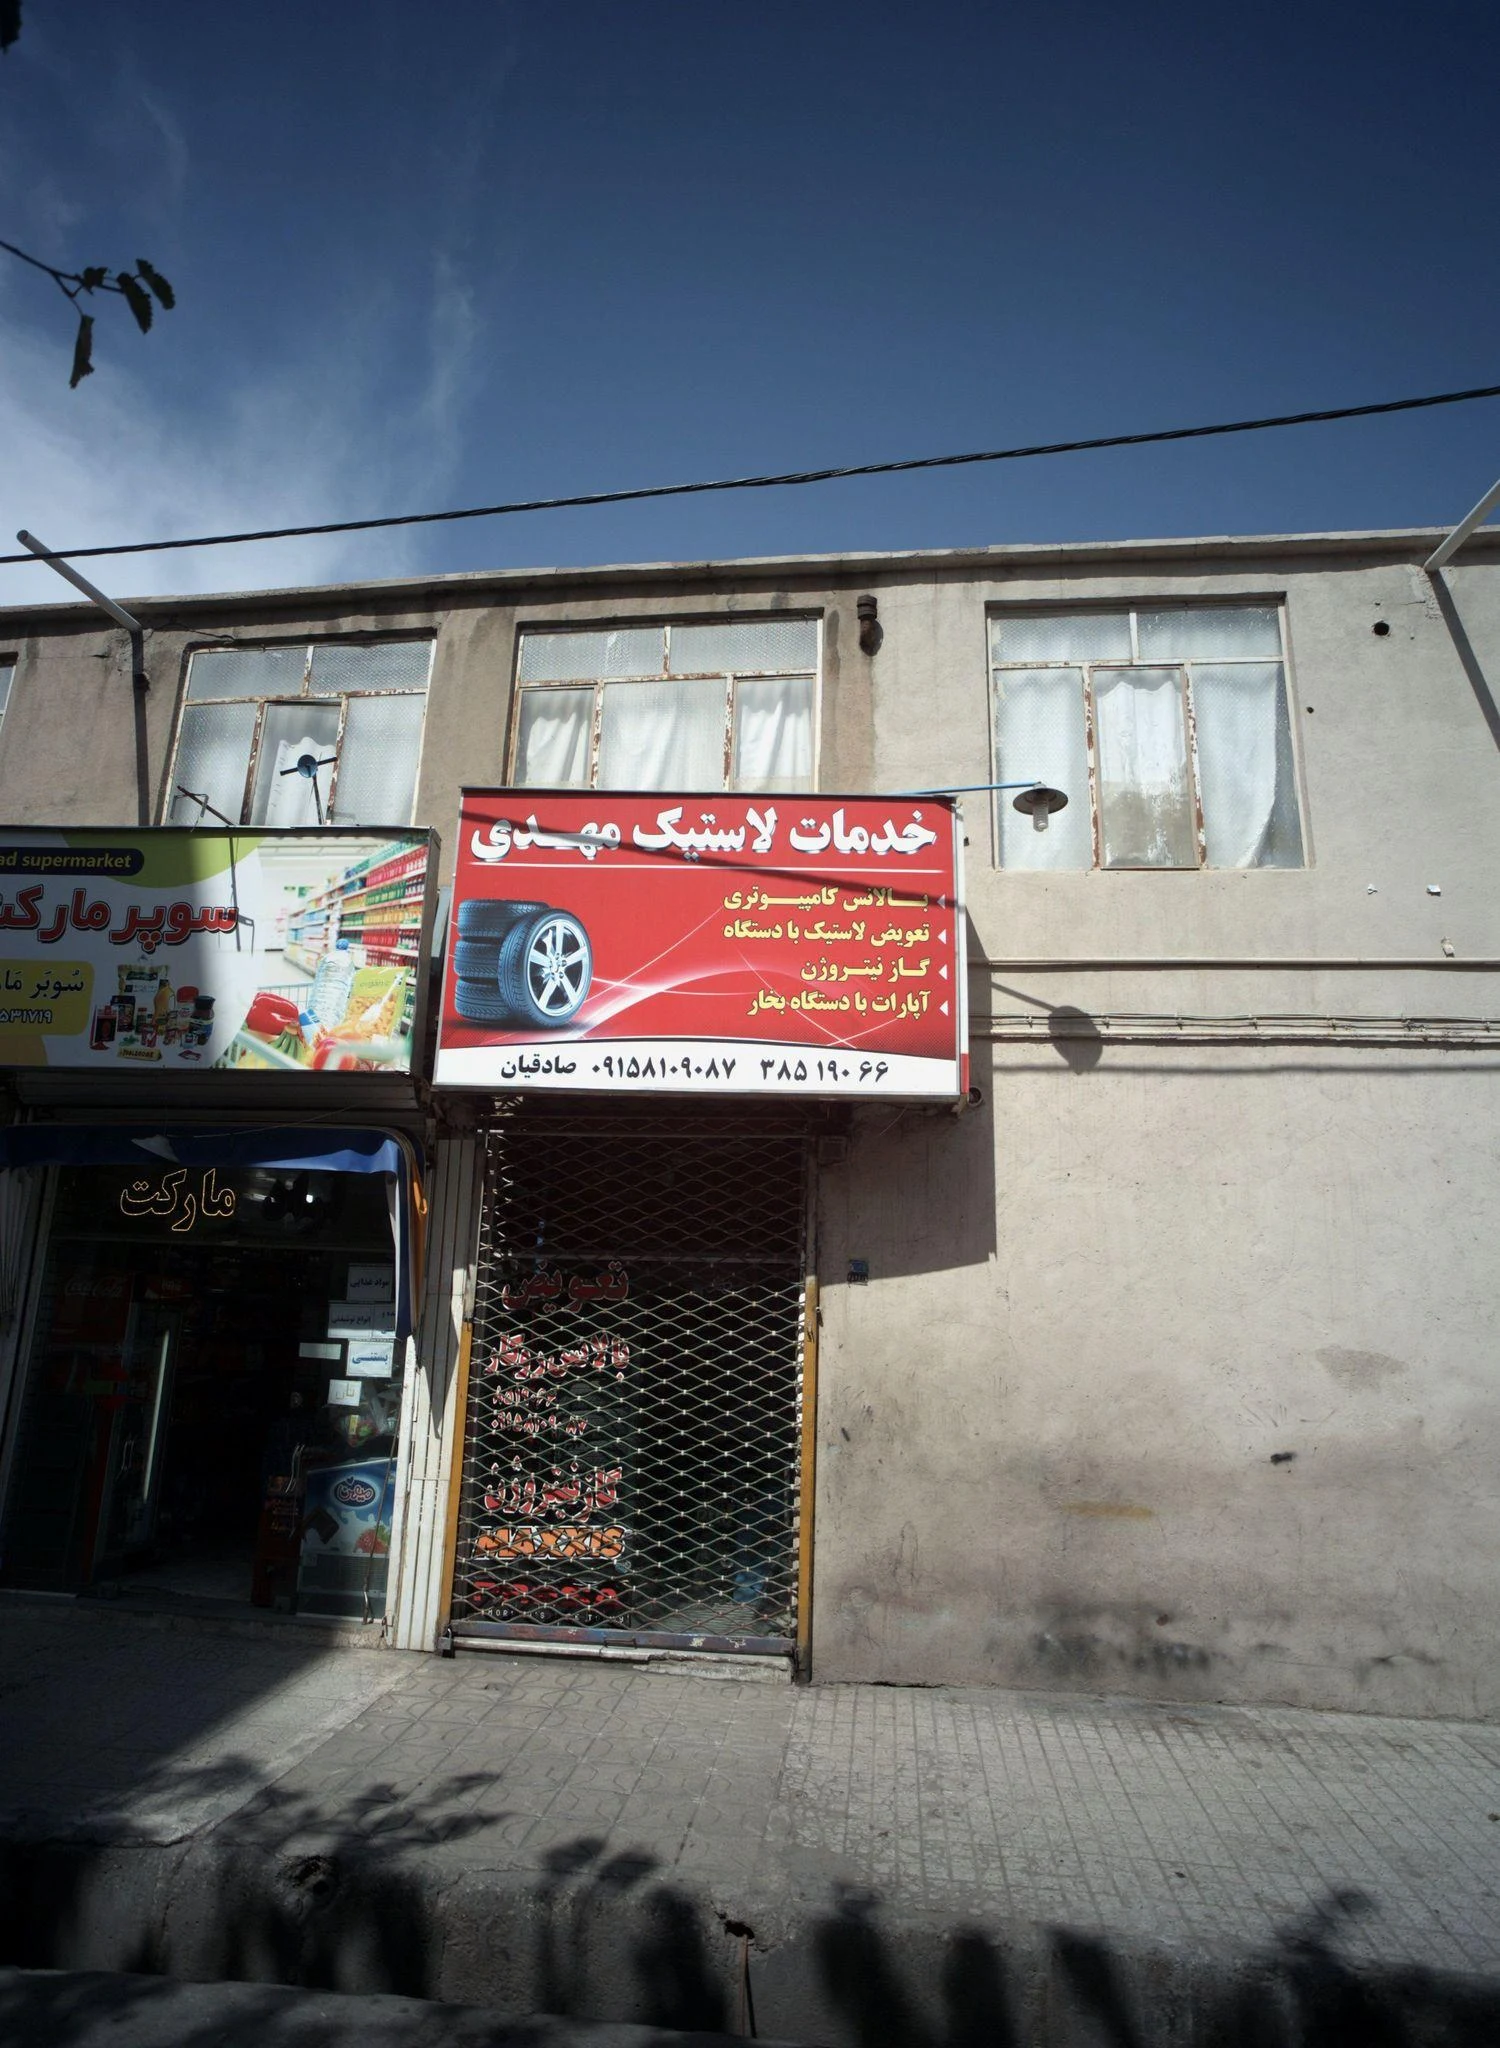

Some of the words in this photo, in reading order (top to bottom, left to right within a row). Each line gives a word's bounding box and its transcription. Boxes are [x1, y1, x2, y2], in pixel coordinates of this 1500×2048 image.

[471, 814, 622, 862] مهدی
[633, 806, 778, 863] لاستیک
[788, 807, 938, 856] خدمات
[21, 852, 133, 871] supermarket
[723, 885, 838, 911] کامپیوتری
[843, 886, 929, 912] بالانس
[109, 902, 239, 954] سوپر
[723, 919, 783, 940] دستگاه
[787, 920, 800, 944] با
[803, 920, 867, 945] لاستیک
[870, 922, 930, 948] تعویض
[800, 956, 883, 982] نیتروژن
[888, 957, 931, 983] گاز
[747, 988, 786, 1015] بخار
[790, 990, 850, 1011] دستگاه
[854, 991, 868, 1016] با
[871, 990, 931, 1020] آپارات
[501, 1053, 577, 1079] صادقیان
[591, 1055, 736, 1080] ۰۹۱۵۸۱۰۹۰۸۷
[120, 1168, 236, 1231] مارکت
[502, 1261, 629, 1314] تعویض
[472, 1525, 626, 1560] MAXXIS
